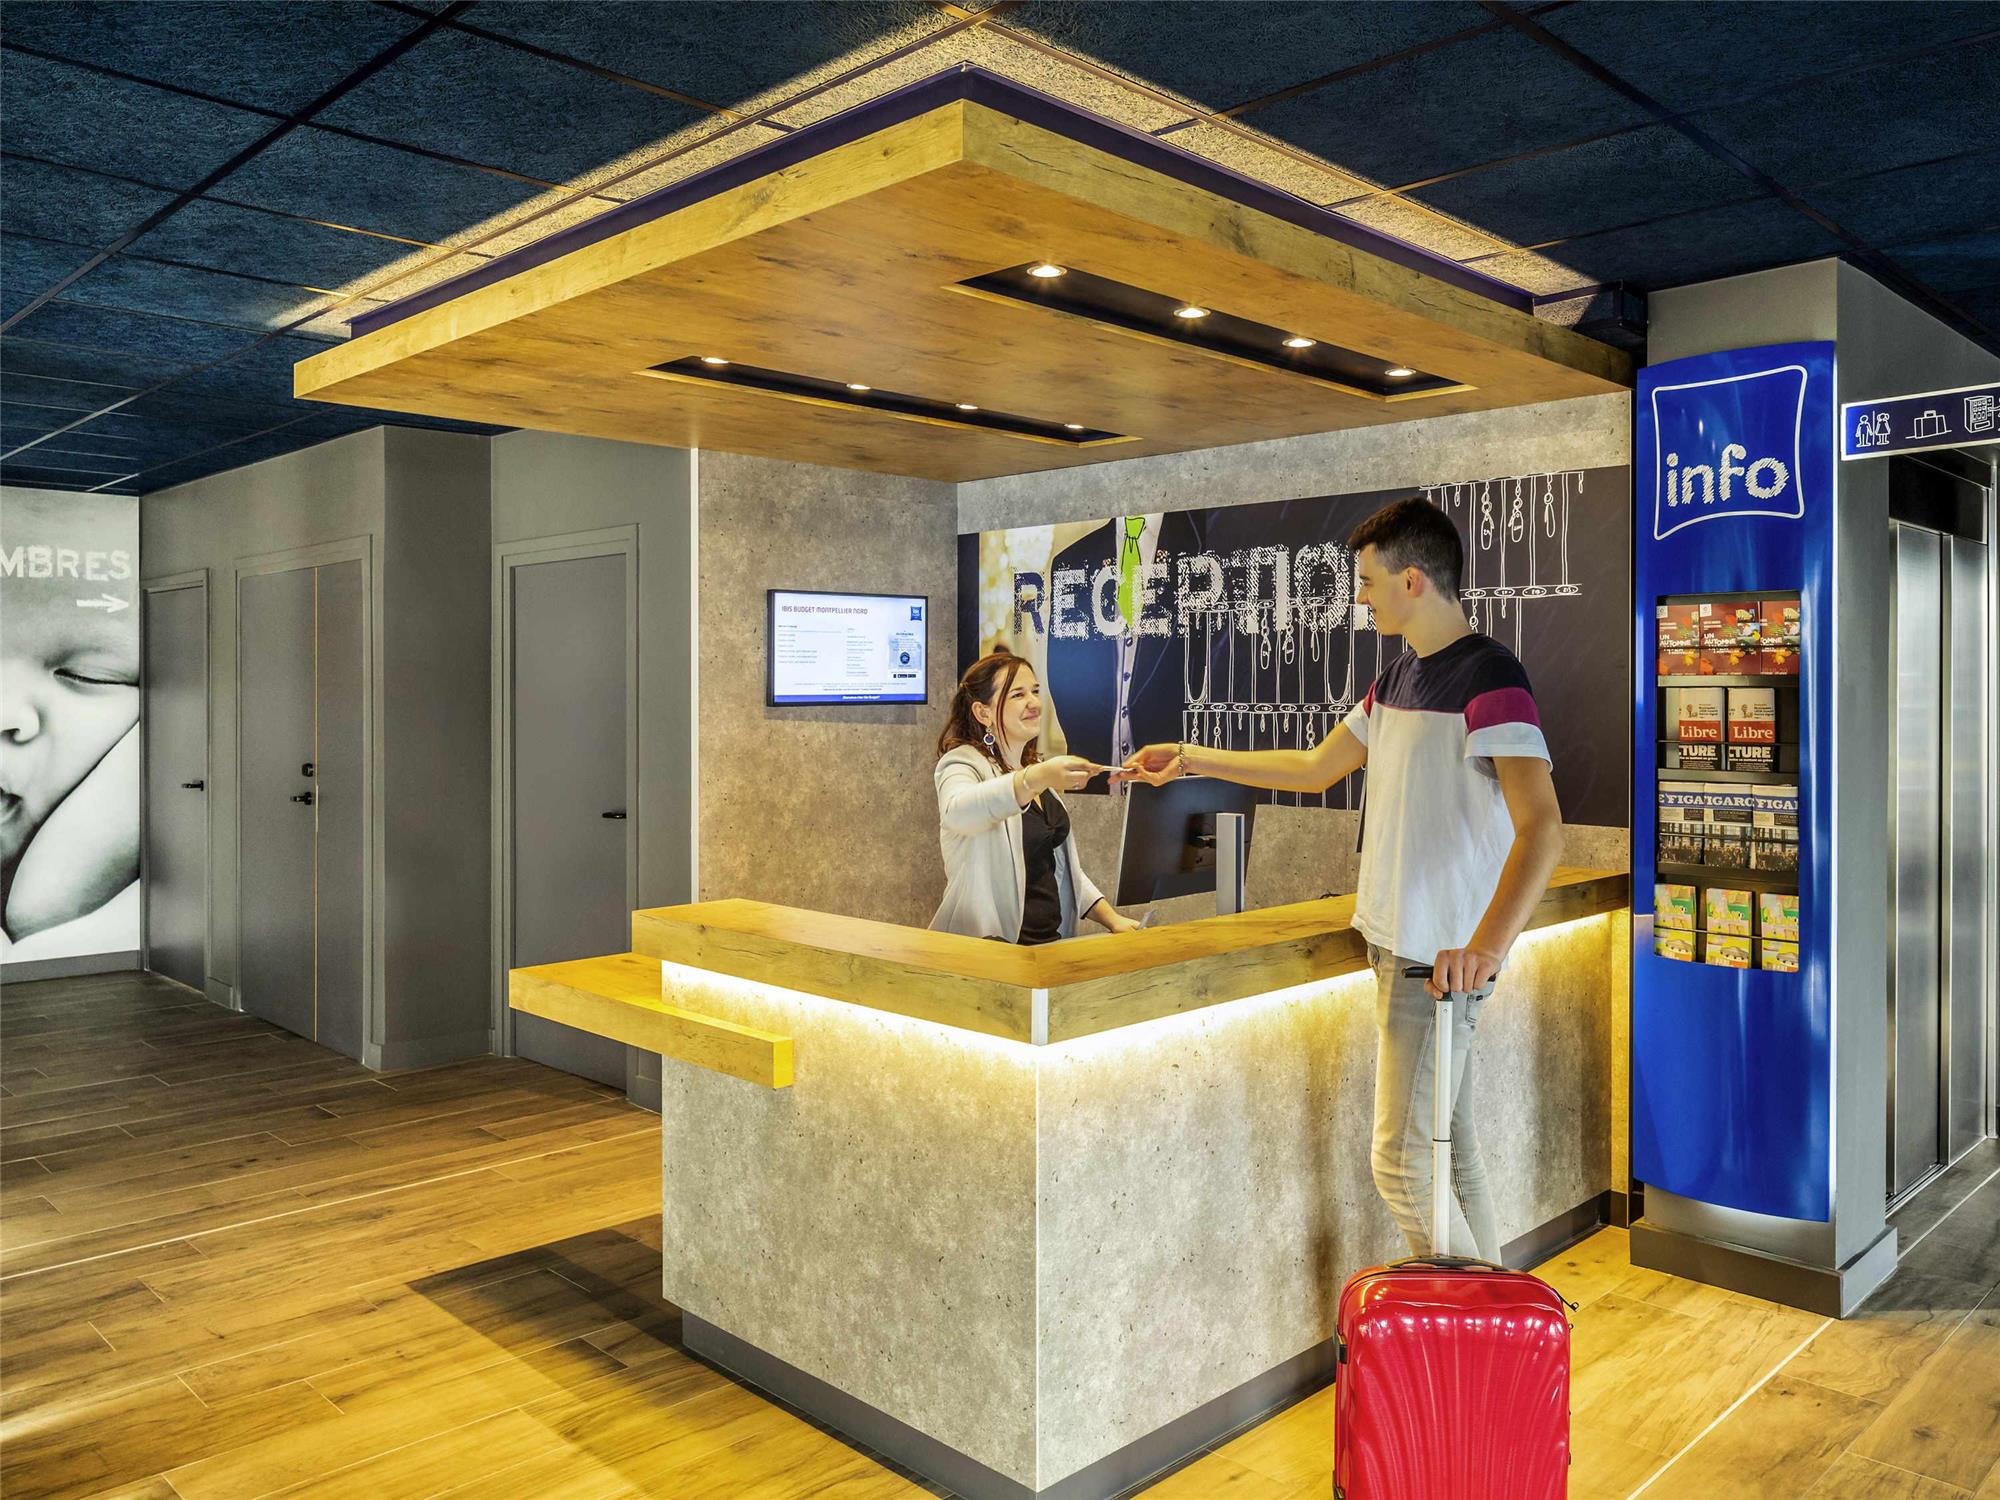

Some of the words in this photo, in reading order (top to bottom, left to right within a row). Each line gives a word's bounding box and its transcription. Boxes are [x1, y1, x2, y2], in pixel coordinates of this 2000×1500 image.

[1666, 444, 1789, 507] info
[0, 544, 131, 581] MBRES
[1679, 725, 1717, 738] Libre
[1733, 726, 1773, 739] Libre
